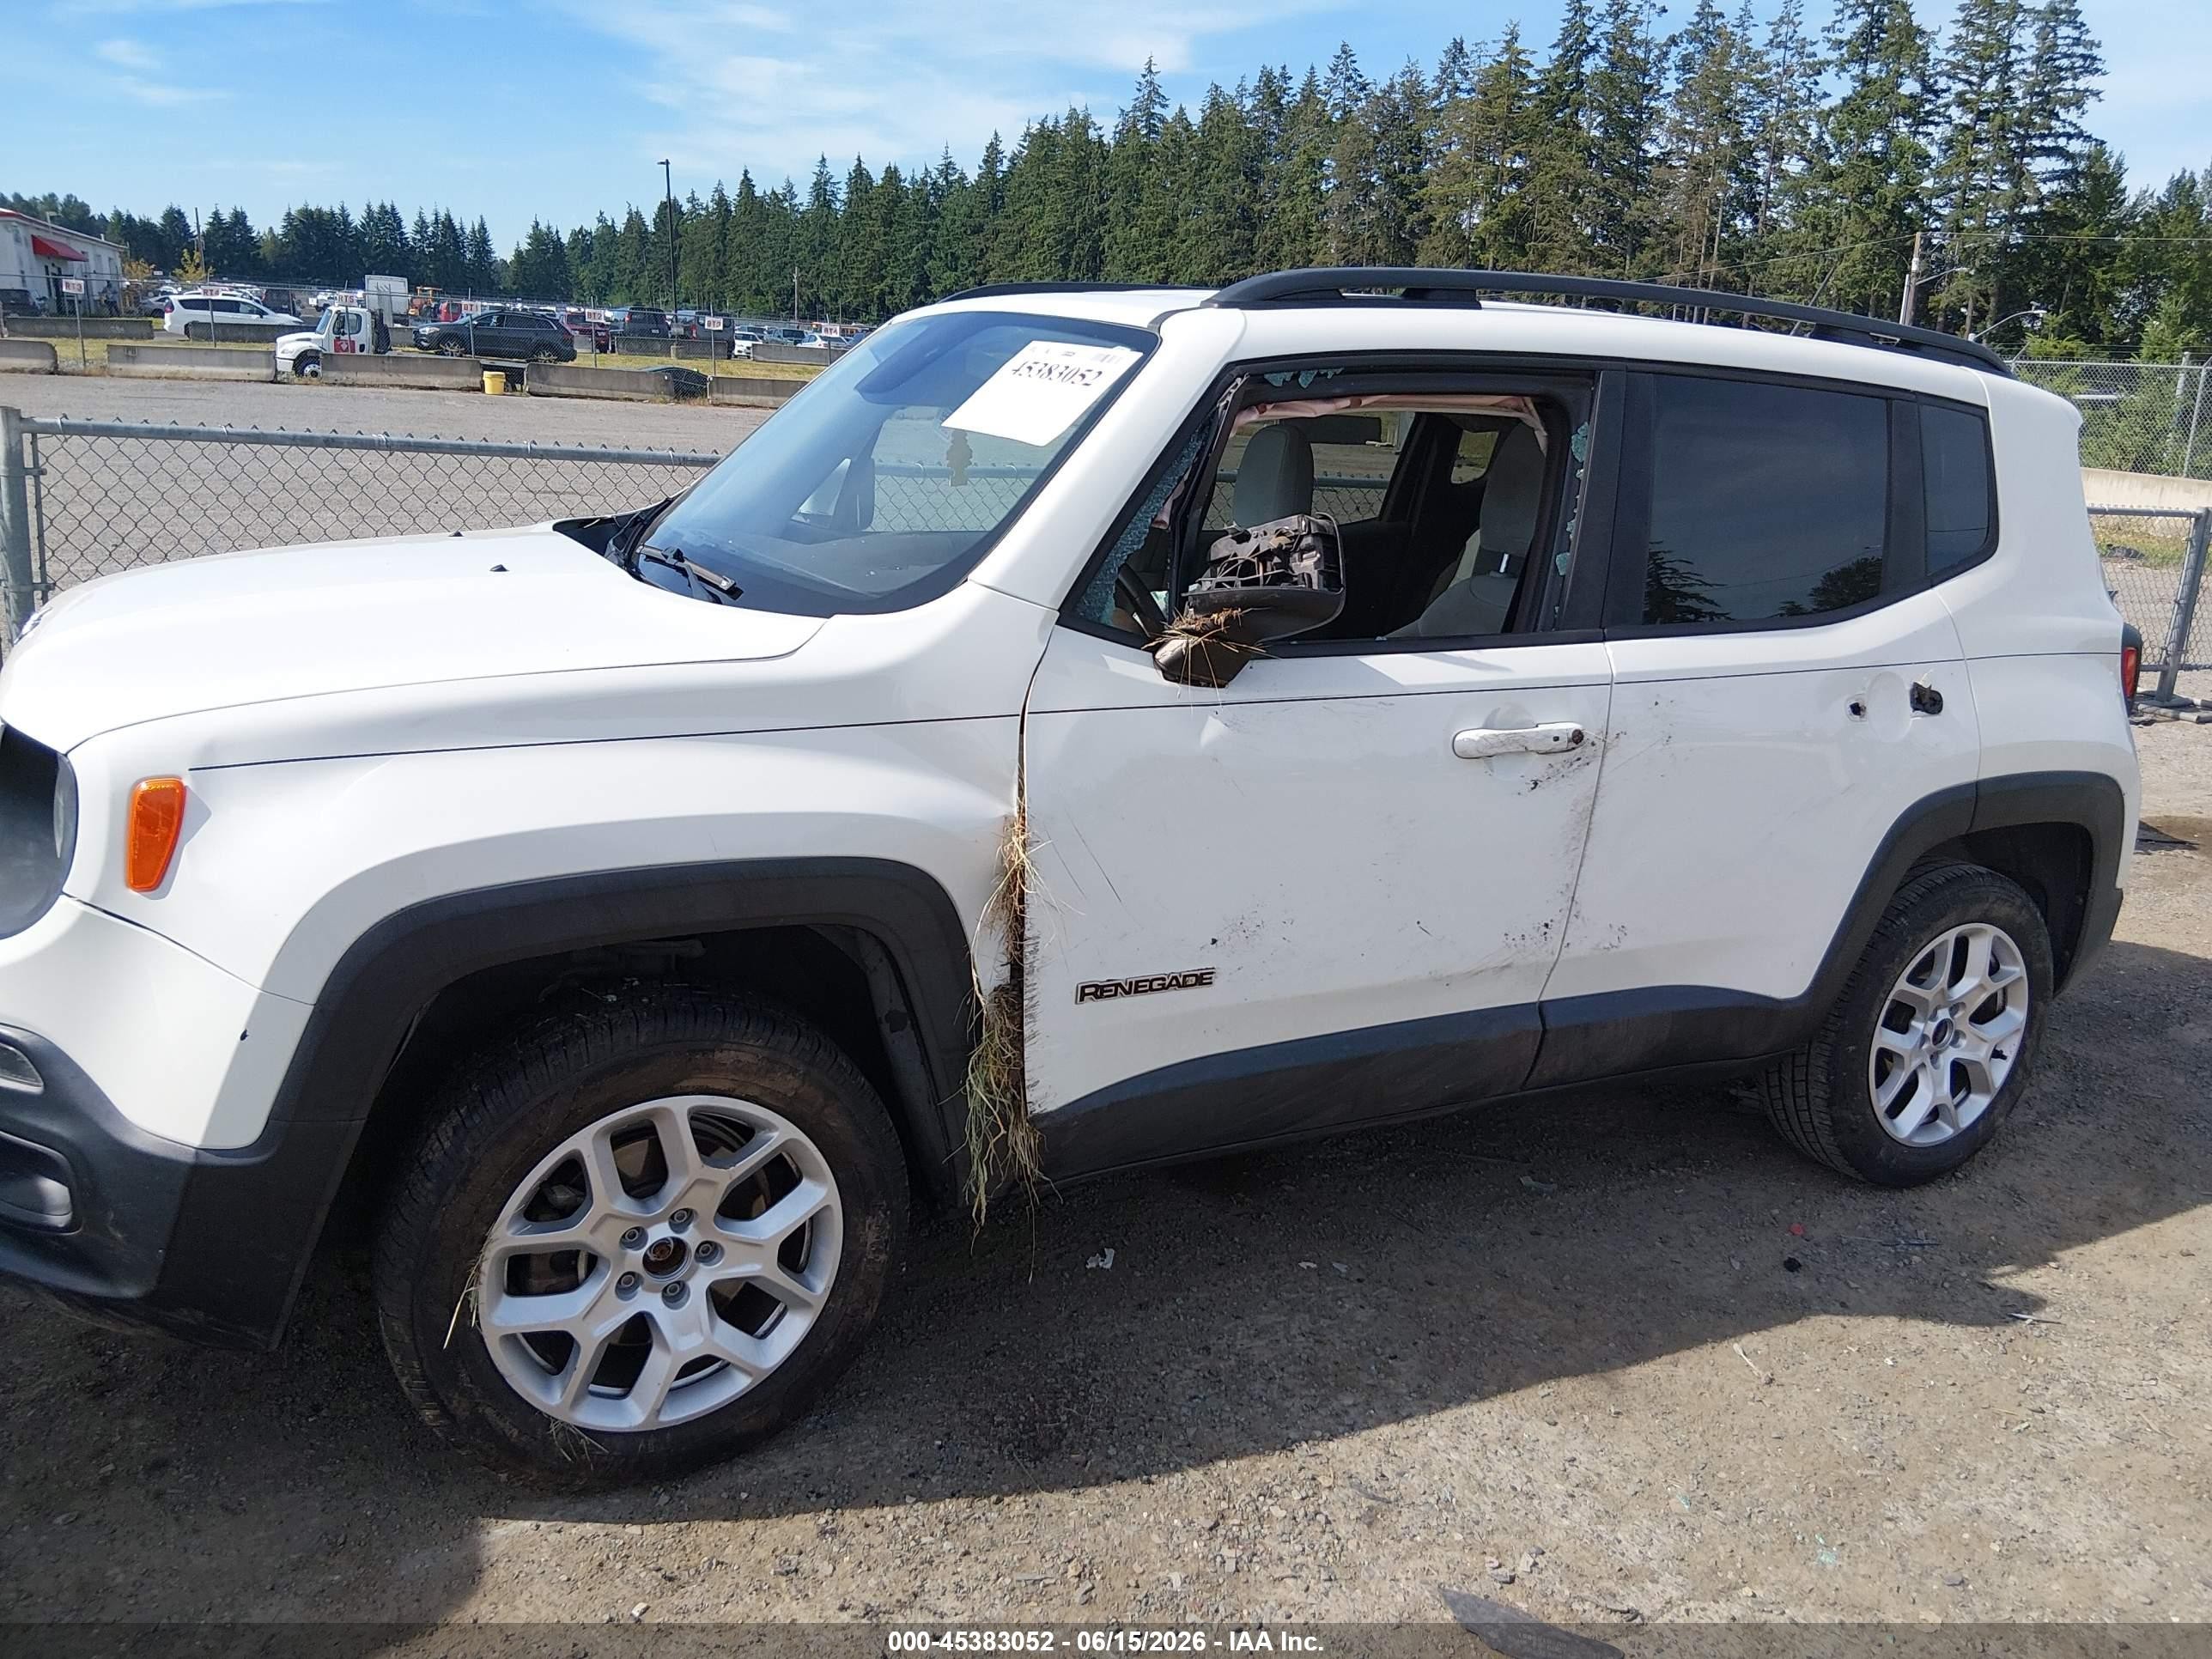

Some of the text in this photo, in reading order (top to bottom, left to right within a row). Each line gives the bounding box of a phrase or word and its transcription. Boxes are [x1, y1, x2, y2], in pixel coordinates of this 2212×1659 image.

[65, 281, 82, 291] RT3
[586, 311, 602, 319] BT2
[1012, 361, 1103, 386] 45383052
[1078, 968, 1216, 1003] RENEGADE
